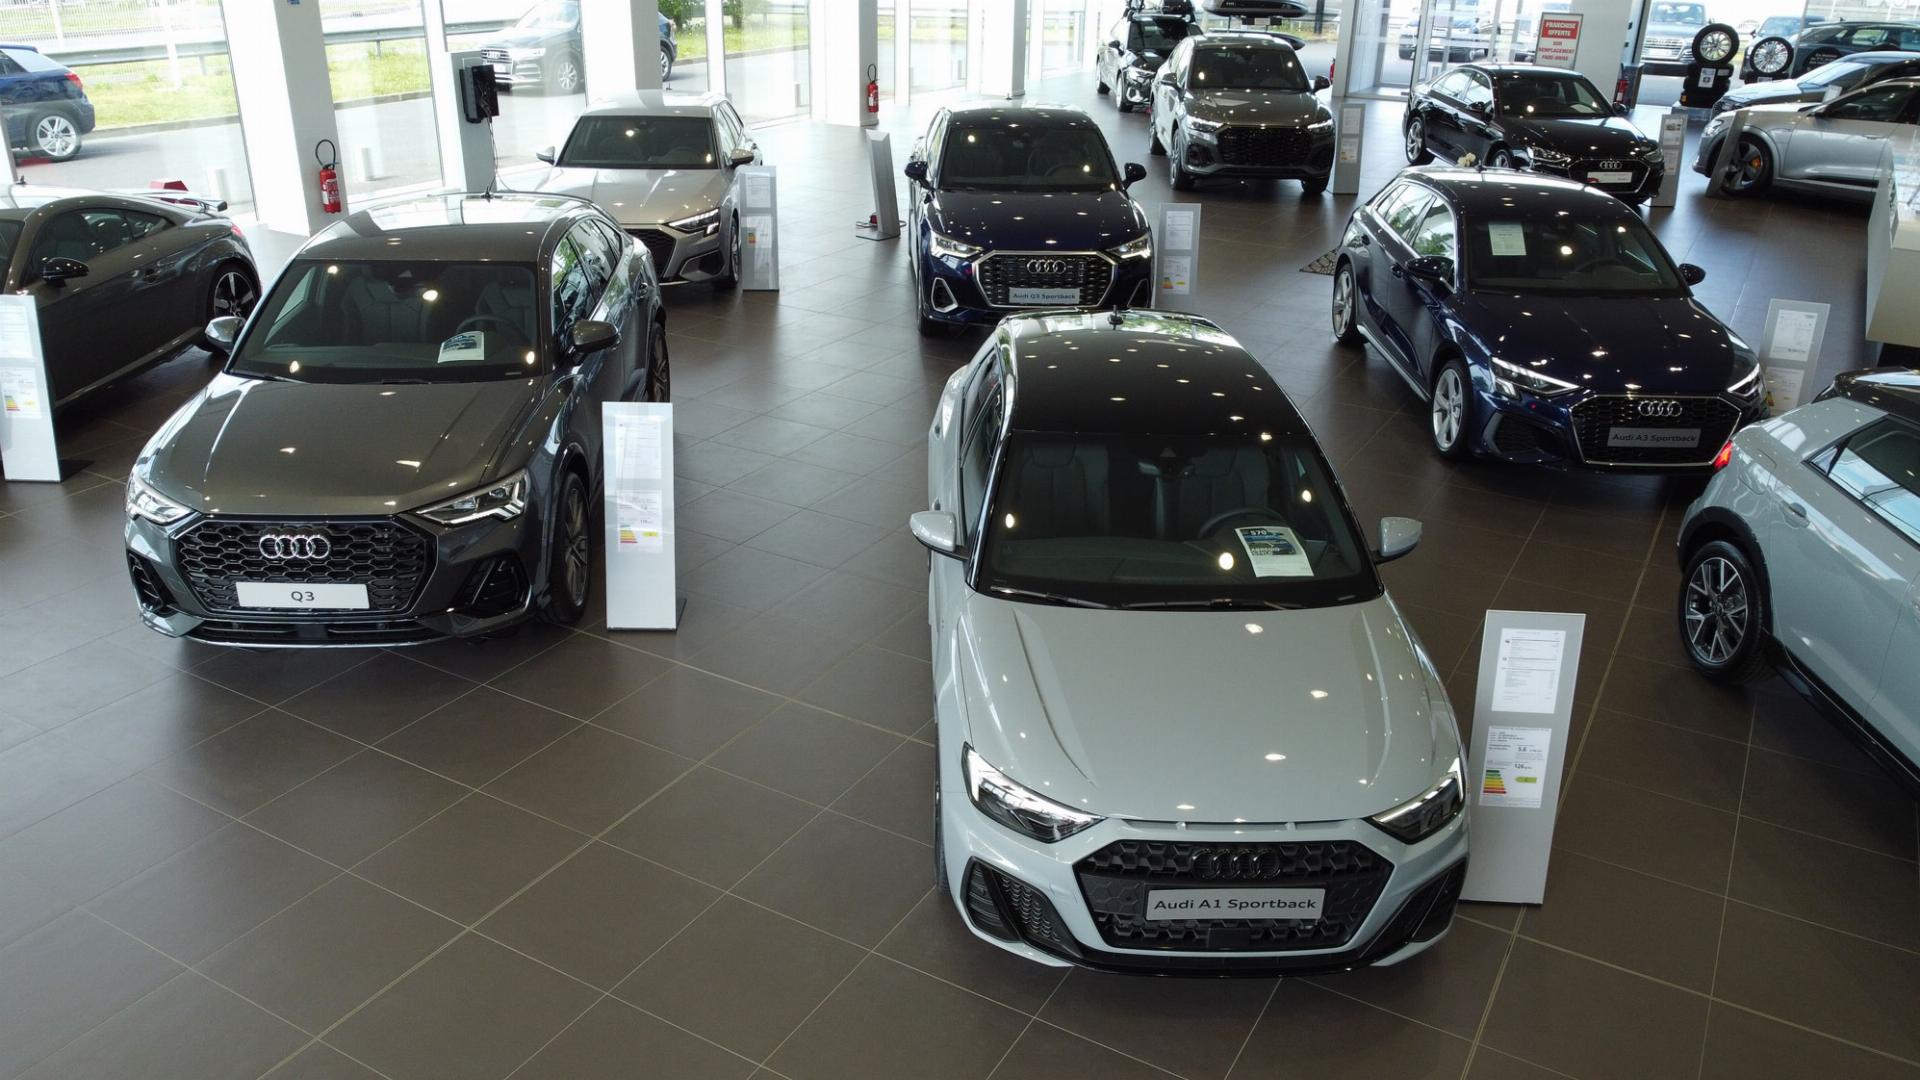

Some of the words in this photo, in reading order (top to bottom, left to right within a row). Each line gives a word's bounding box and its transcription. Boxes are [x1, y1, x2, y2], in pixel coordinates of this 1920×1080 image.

[1042, 293, 1076, 301] Sportback
[1613, 433, 1634, 441] Audi
[1635, 433, 1648, 441] A3
[1650, 433, 1697, 443] Sportback
[291, 591, 315, 603] Q3
[1154, 899, 1195, 910] Audi
[1198, 899, 1222, 909] A1
[1227, 899, 1317, 911] Sportback
